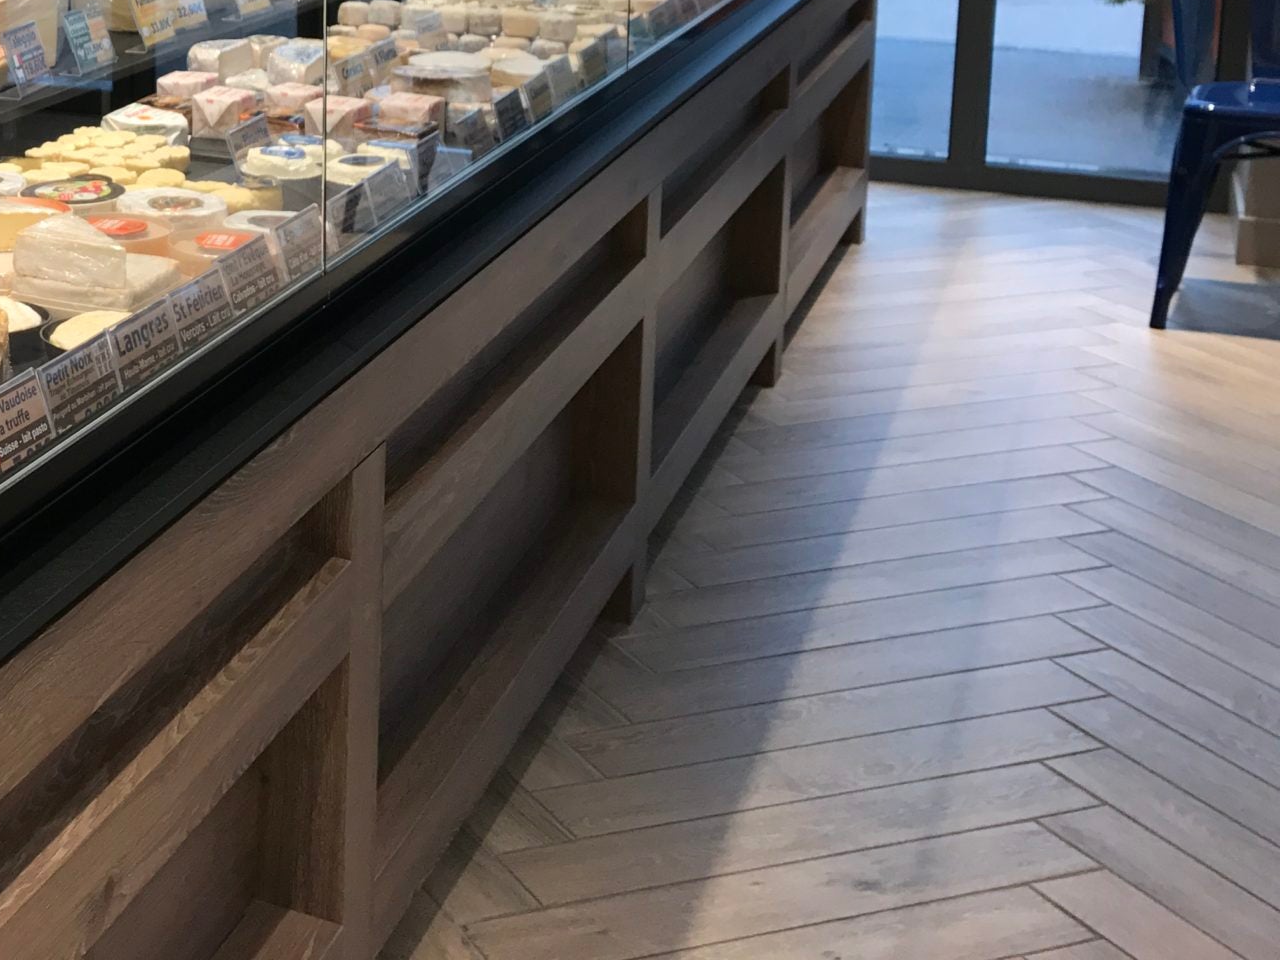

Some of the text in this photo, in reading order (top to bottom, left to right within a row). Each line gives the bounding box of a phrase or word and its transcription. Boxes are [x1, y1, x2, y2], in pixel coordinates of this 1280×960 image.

[173, 301, 187, 322] St
[114, 311, 169, 357] Langres
[180, 320, 206, 343] Vercors
[46, 367, 70, 389] Petit
[69, 351, 93, 372] Noix
[5, 407, 31, 431] truffe
[21, 430, 32, 442] lait
[31, 422, 48, 440] pasto
